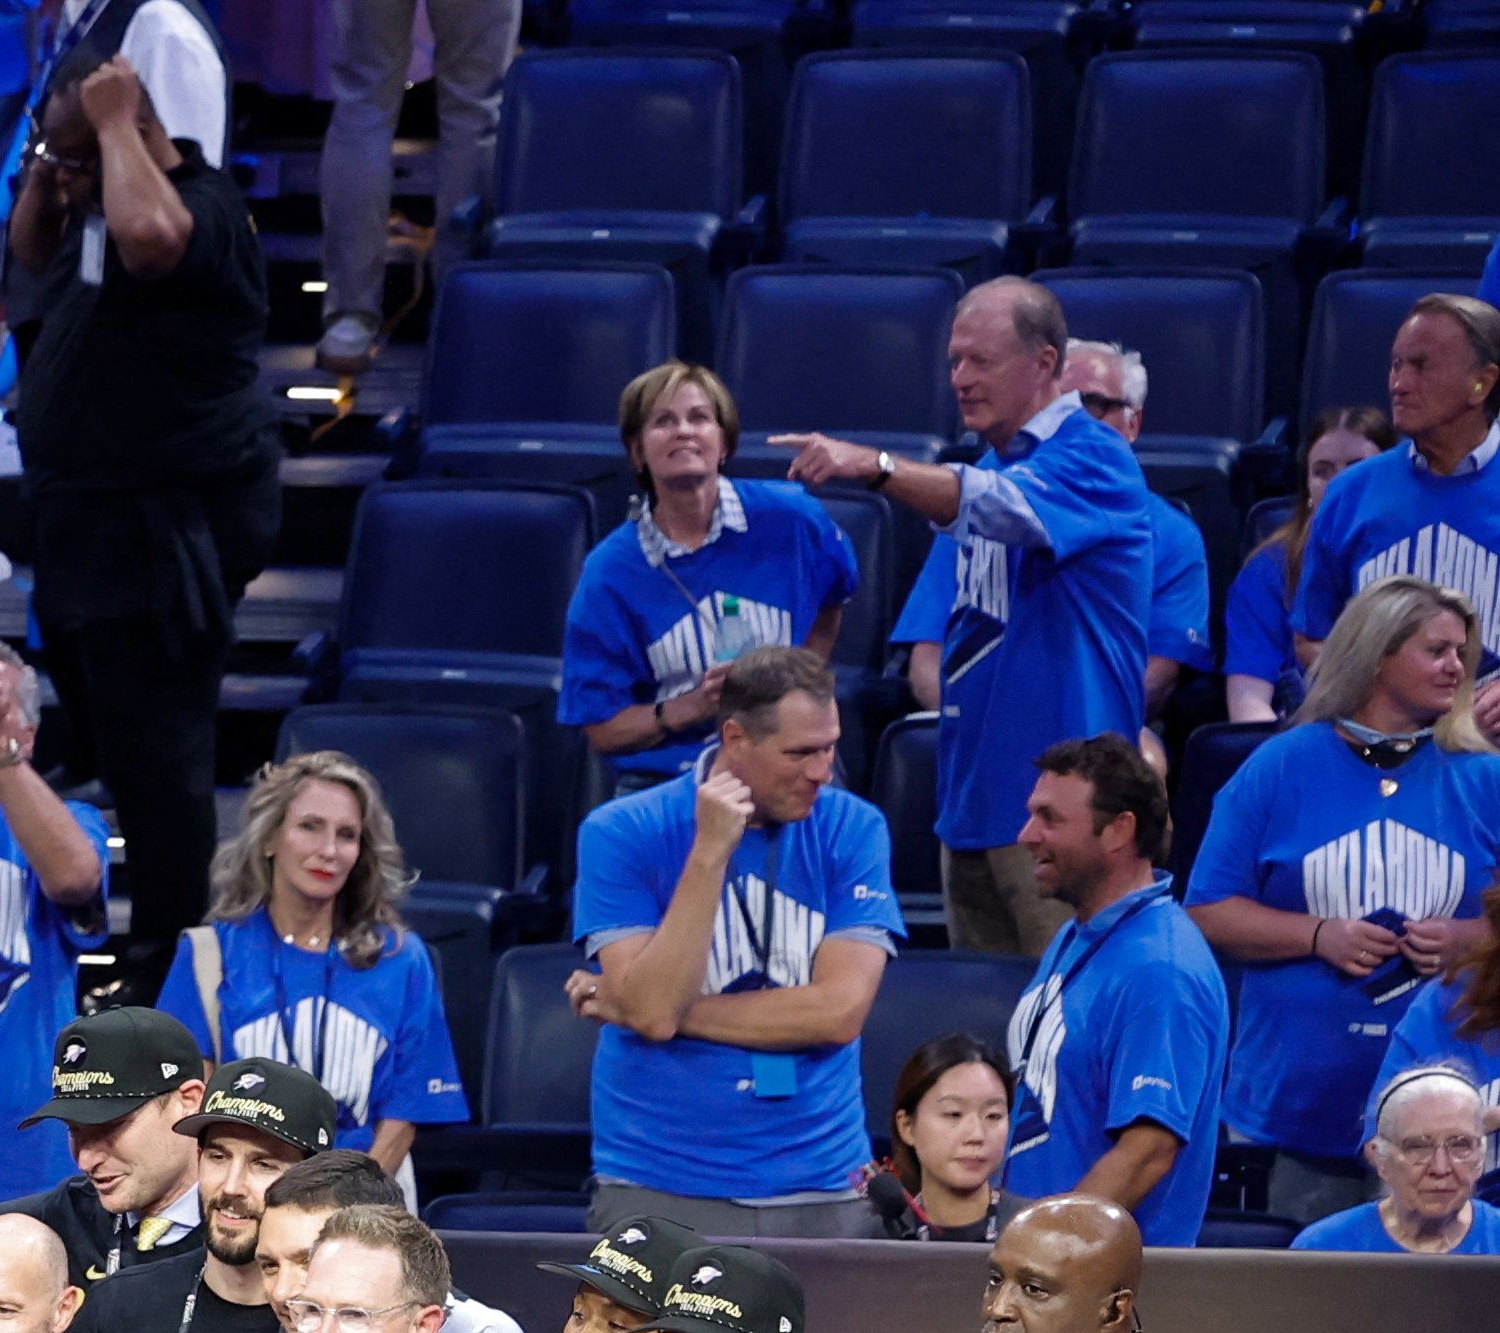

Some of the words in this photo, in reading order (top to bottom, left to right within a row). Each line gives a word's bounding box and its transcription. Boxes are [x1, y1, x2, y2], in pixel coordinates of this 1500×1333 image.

[1303, 818, 1466, 920] OKLAHOMA
[205, 1092, 286, 1122] Champions
[664, 1284, 742, 1319] Champions
